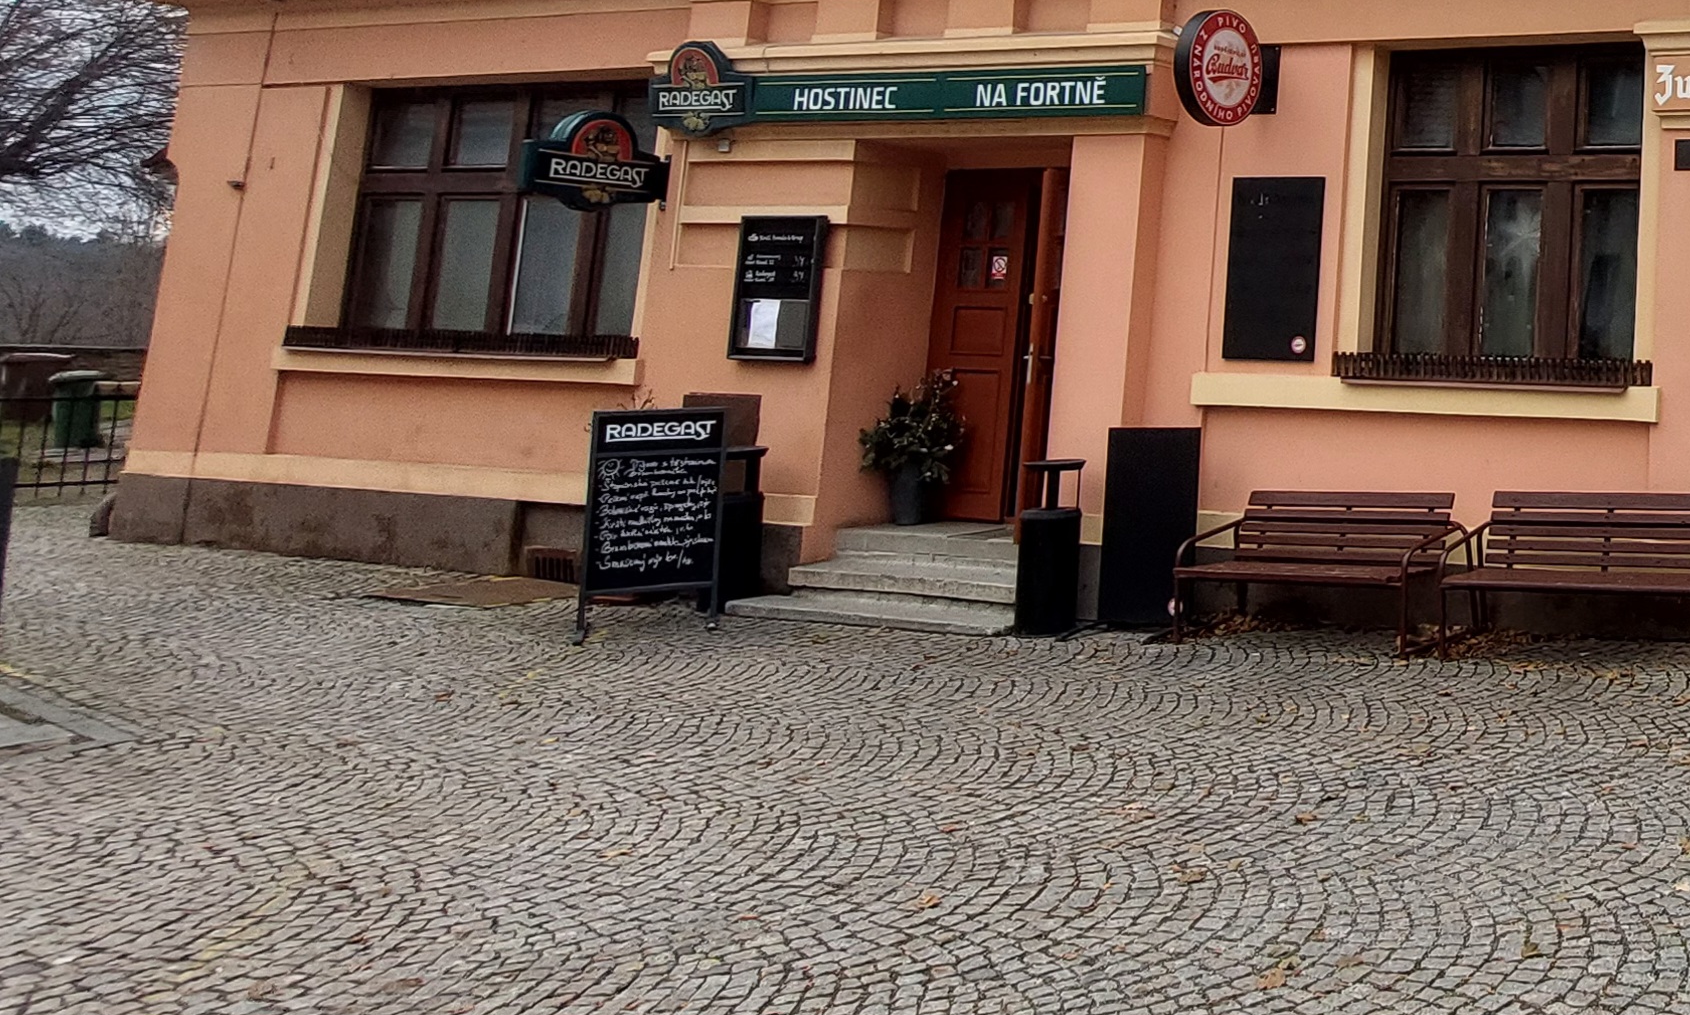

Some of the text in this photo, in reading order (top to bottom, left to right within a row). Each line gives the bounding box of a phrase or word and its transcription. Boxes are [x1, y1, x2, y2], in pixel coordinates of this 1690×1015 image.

[1217, 15, 1246, 33] PIVO
[658, 89, 737, 111] RADEGAST
[793, 76, 1106, 110] HOSTINEC NA FORTNĚ
[549, 157, 649, 188] RADEGAST
[606, 420, 717, 442] RADEGAST
